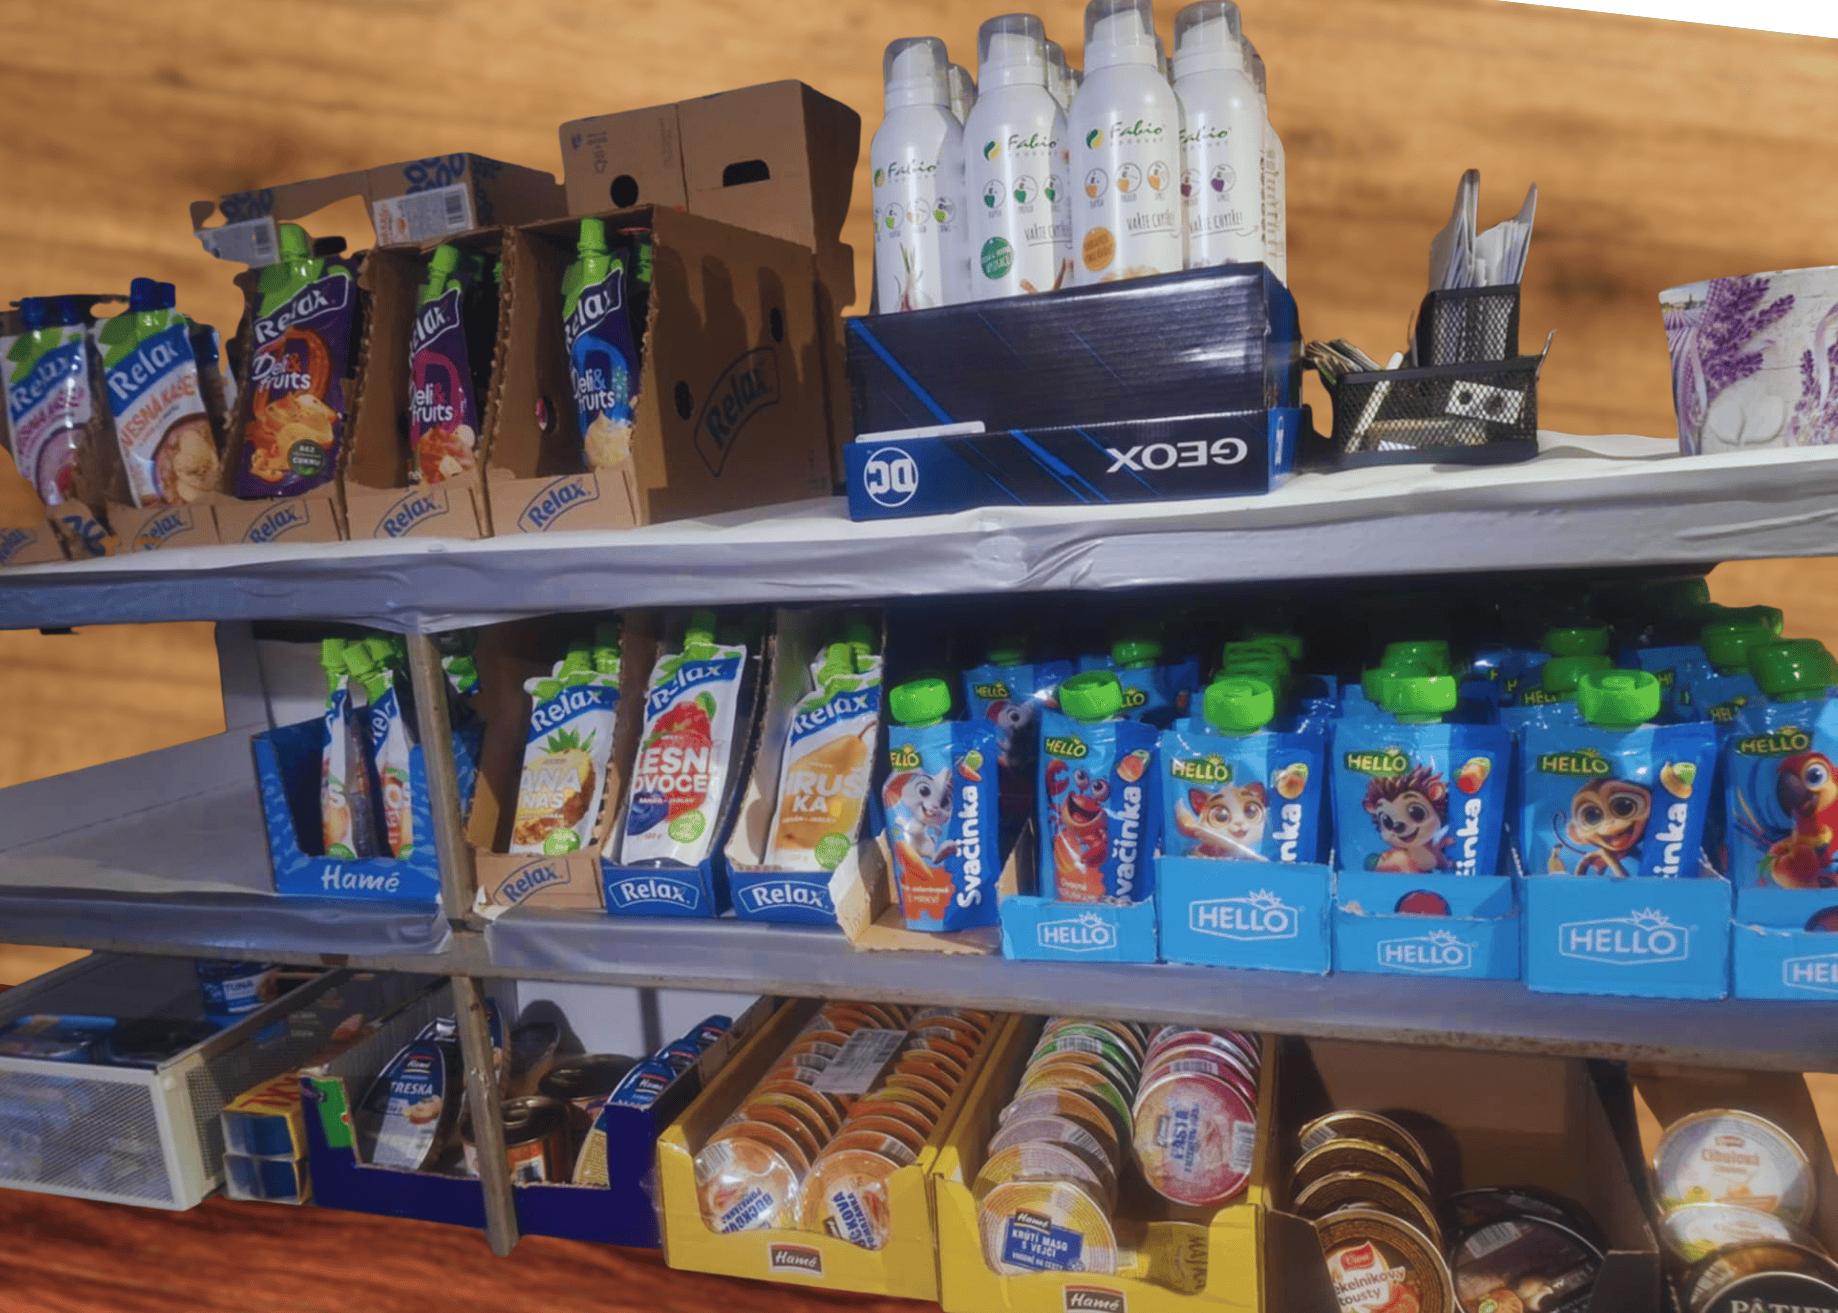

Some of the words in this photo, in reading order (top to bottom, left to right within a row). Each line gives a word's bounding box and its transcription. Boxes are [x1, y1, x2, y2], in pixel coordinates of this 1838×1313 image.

[1007, 133, 1057, 150] Fabio
[1109, 119, 1164, 139] Fabio
[255, 290, 328, 343] Relax
[108, 341, 178, 400] Relax
[706, 367, 769, 447] Relax
[1105, 437, 1248, 473] GEOX
[868, 458, 917, 495] DC
[383, 495, 437, 538] Relax
[528, 483, 587, 527] Relax
[250, 507, 297, 543] Relax
[531, 689, 600, 732] Relax
[792, 694, 868, 736] Relax
[1045, 738, 1088, 758] HELLO
[1740, 731, 1808, 752] HELLO
[1172, 759, 1232, 782] HELLO
[1348, 754, 1407, 772] HELLO
[1542, 756, 1609, 774] HELLO
[791, 796, 828, 813] KA
[956, 785, 982, 908] Svačinka
[321, 865, 401, 893] Hamé
[503, 863, 558, 903] Relax
[621, 879, 686, 903] Relax
[752, 883, 824, 909] Relax
[1199, 906, 1289, 933] HELLO
[1044, 926, 1110, 945] HELLO
[1570, 928, 1677, 955] HELLO
[1385, 943, 1464, 965] HELLO
[390, 1081, 433, 1096] TRESKA
[1017, 1212, 1049, 1229] Hamé
[1042, 1236, 1068, 1252] MASO
[774, 1250, 818, 1268] Hamé
[1070, 1293, 1121, 1312] Hamé
